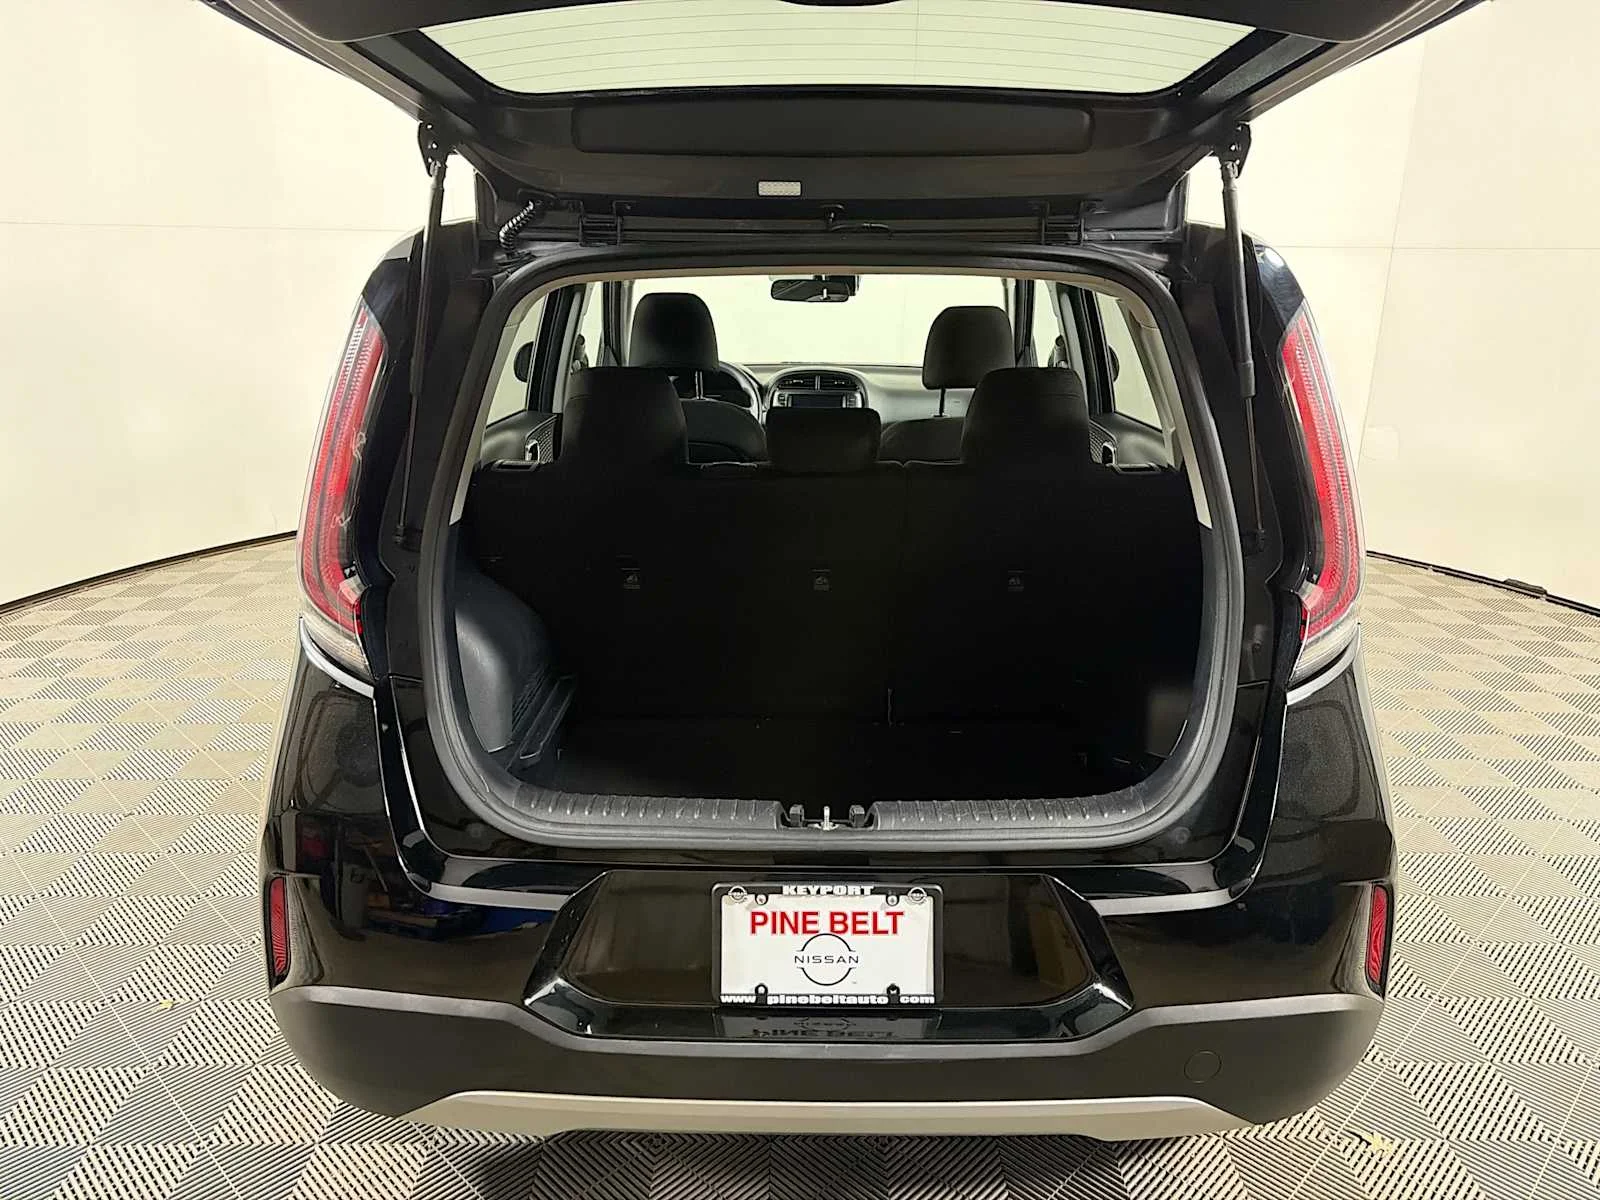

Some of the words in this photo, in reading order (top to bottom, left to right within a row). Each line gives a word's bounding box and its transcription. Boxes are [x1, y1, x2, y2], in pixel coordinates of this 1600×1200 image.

[782, 885, 874, 896] KEYPORT
[750, 911, 819, 935] PINE
[829, 911, 904, 935] BELT
[794, 955, 859, 964] NISSAN
